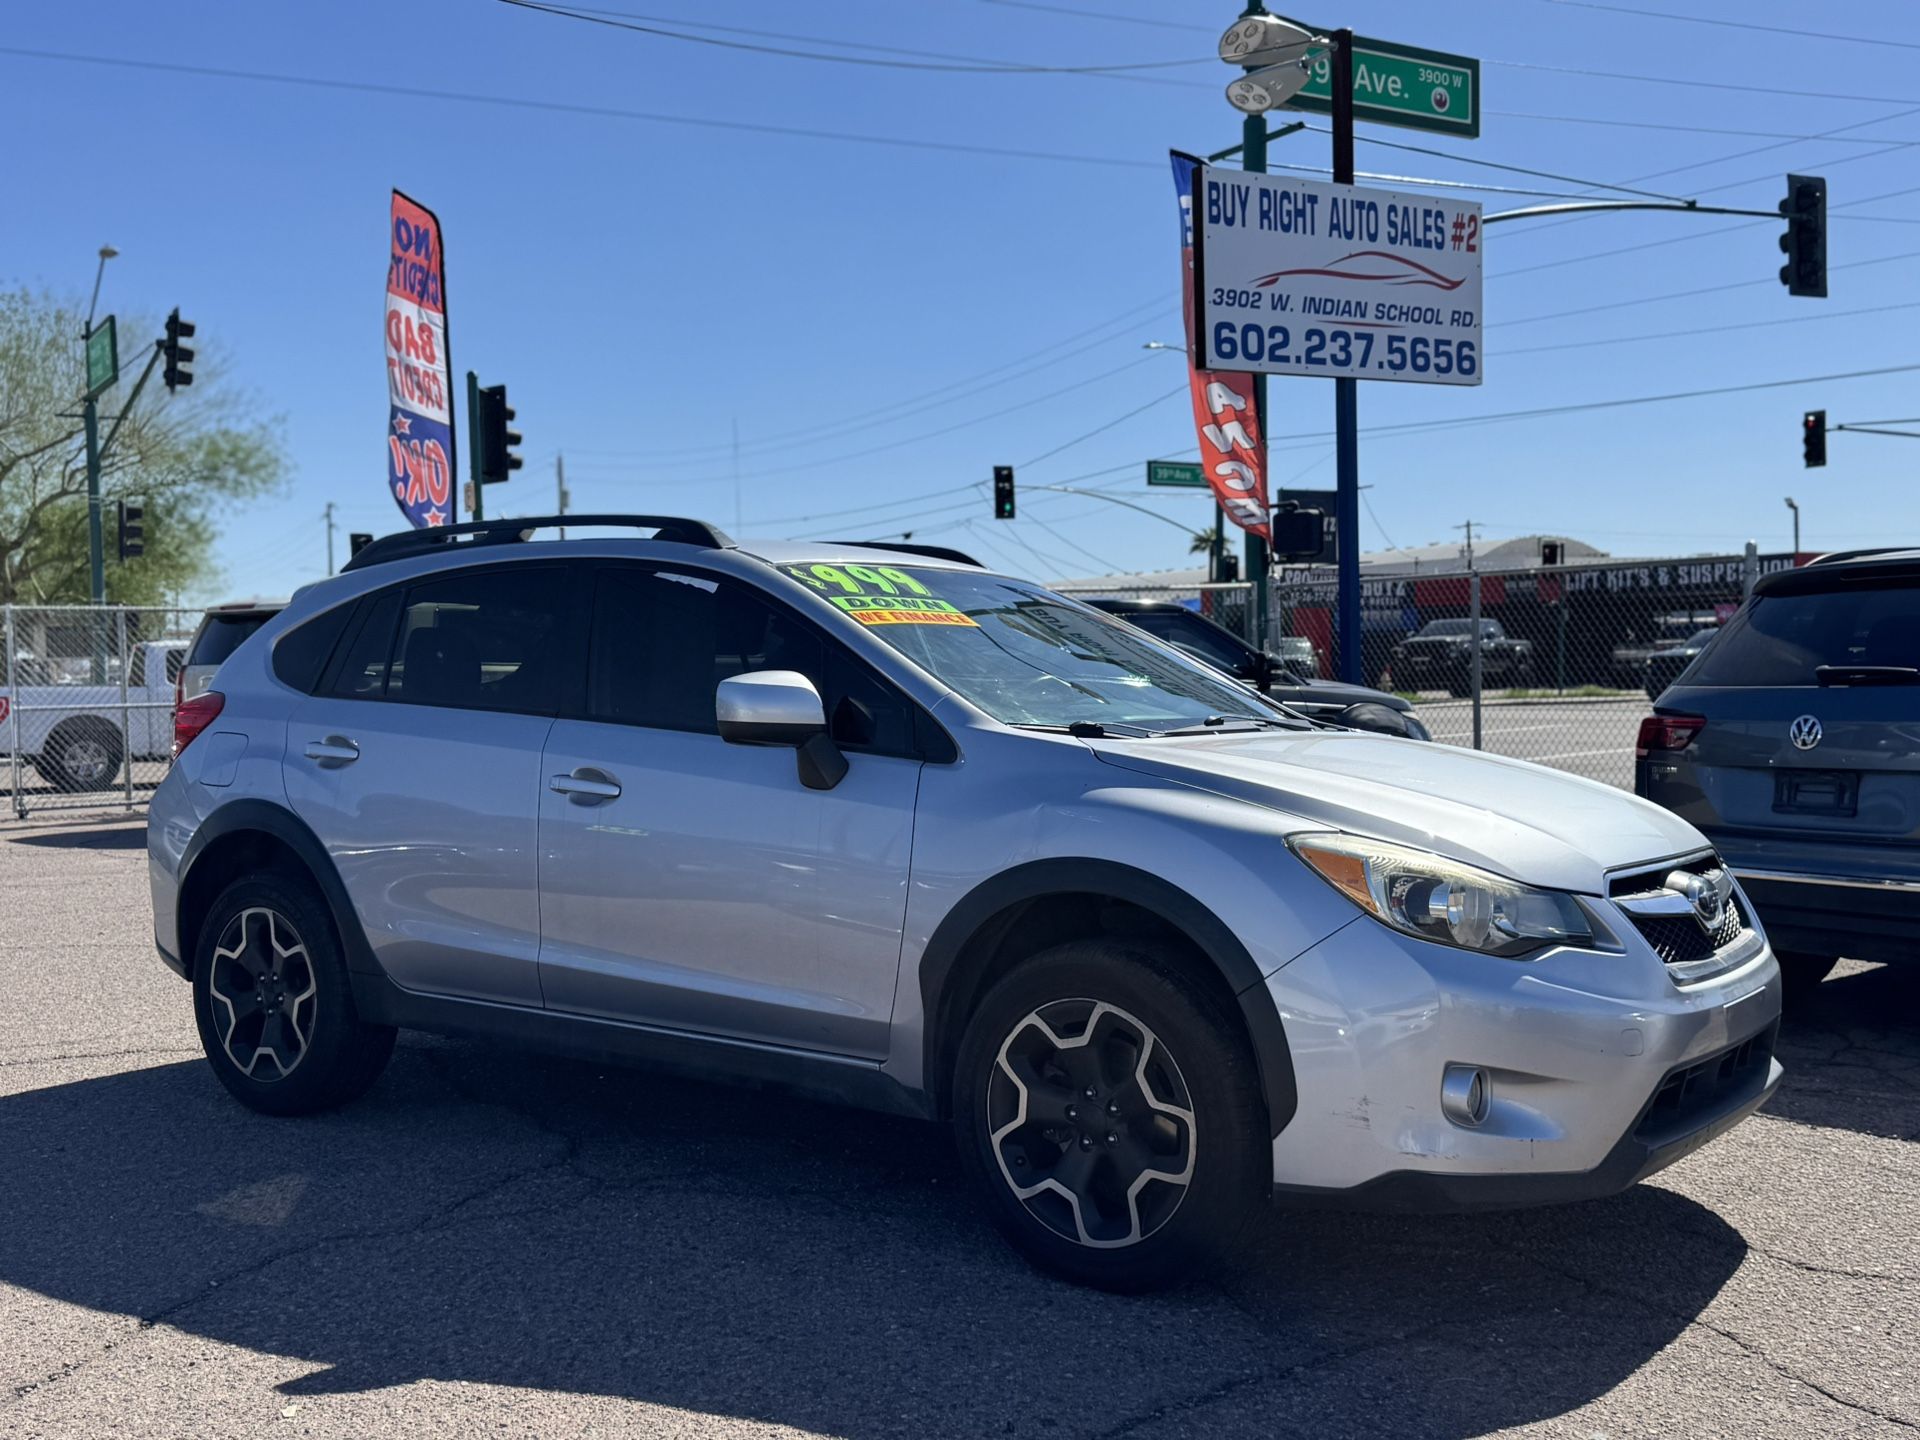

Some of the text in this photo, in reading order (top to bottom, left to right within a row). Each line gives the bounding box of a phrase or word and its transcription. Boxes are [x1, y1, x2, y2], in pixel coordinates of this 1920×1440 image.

[1354, 63, 1409, 98] Ave.
[1418, 68, 1463, 88] 3900 W
[1207, 180, 1250, 228] BUY
[1259, 188, 1318, 236] RIGHT
[1328, 197, 1379, 243] AUTO
[1387, 203, 1446, 250] SALES
[1451, 213, 1479, 253] #2
[1212, 288, 1477, 328] 3902 W. INDIAN SCHOOL RD.
[1213, 321, 1477, 376] 602.237.5656
[787, 564, 932, 597] $999
[1566, 559, 1795, 591] LIFT KIT'S & SUSPEION
[845, 598, 948, 612] DOWN
[855, 611, 974, 625] WE FINANCE
